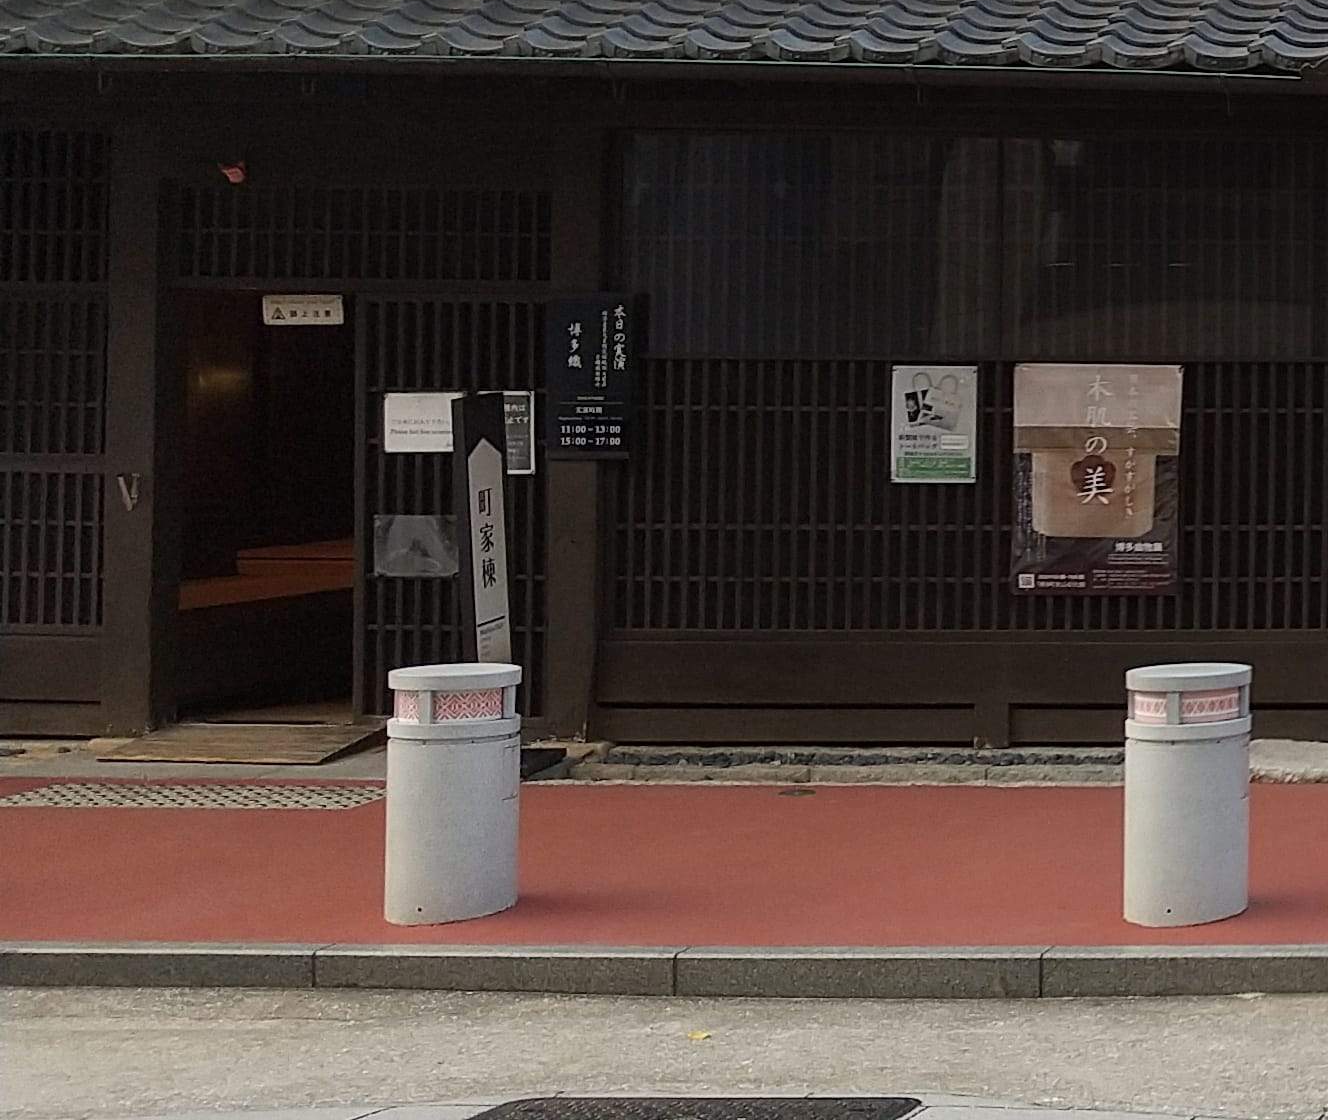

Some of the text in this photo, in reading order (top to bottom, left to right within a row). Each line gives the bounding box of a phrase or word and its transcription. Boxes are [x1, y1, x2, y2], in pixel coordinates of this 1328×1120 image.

[1076, 373, 1115, 505] 木肌の美
[477, 487, 497, 590] 町家棟
